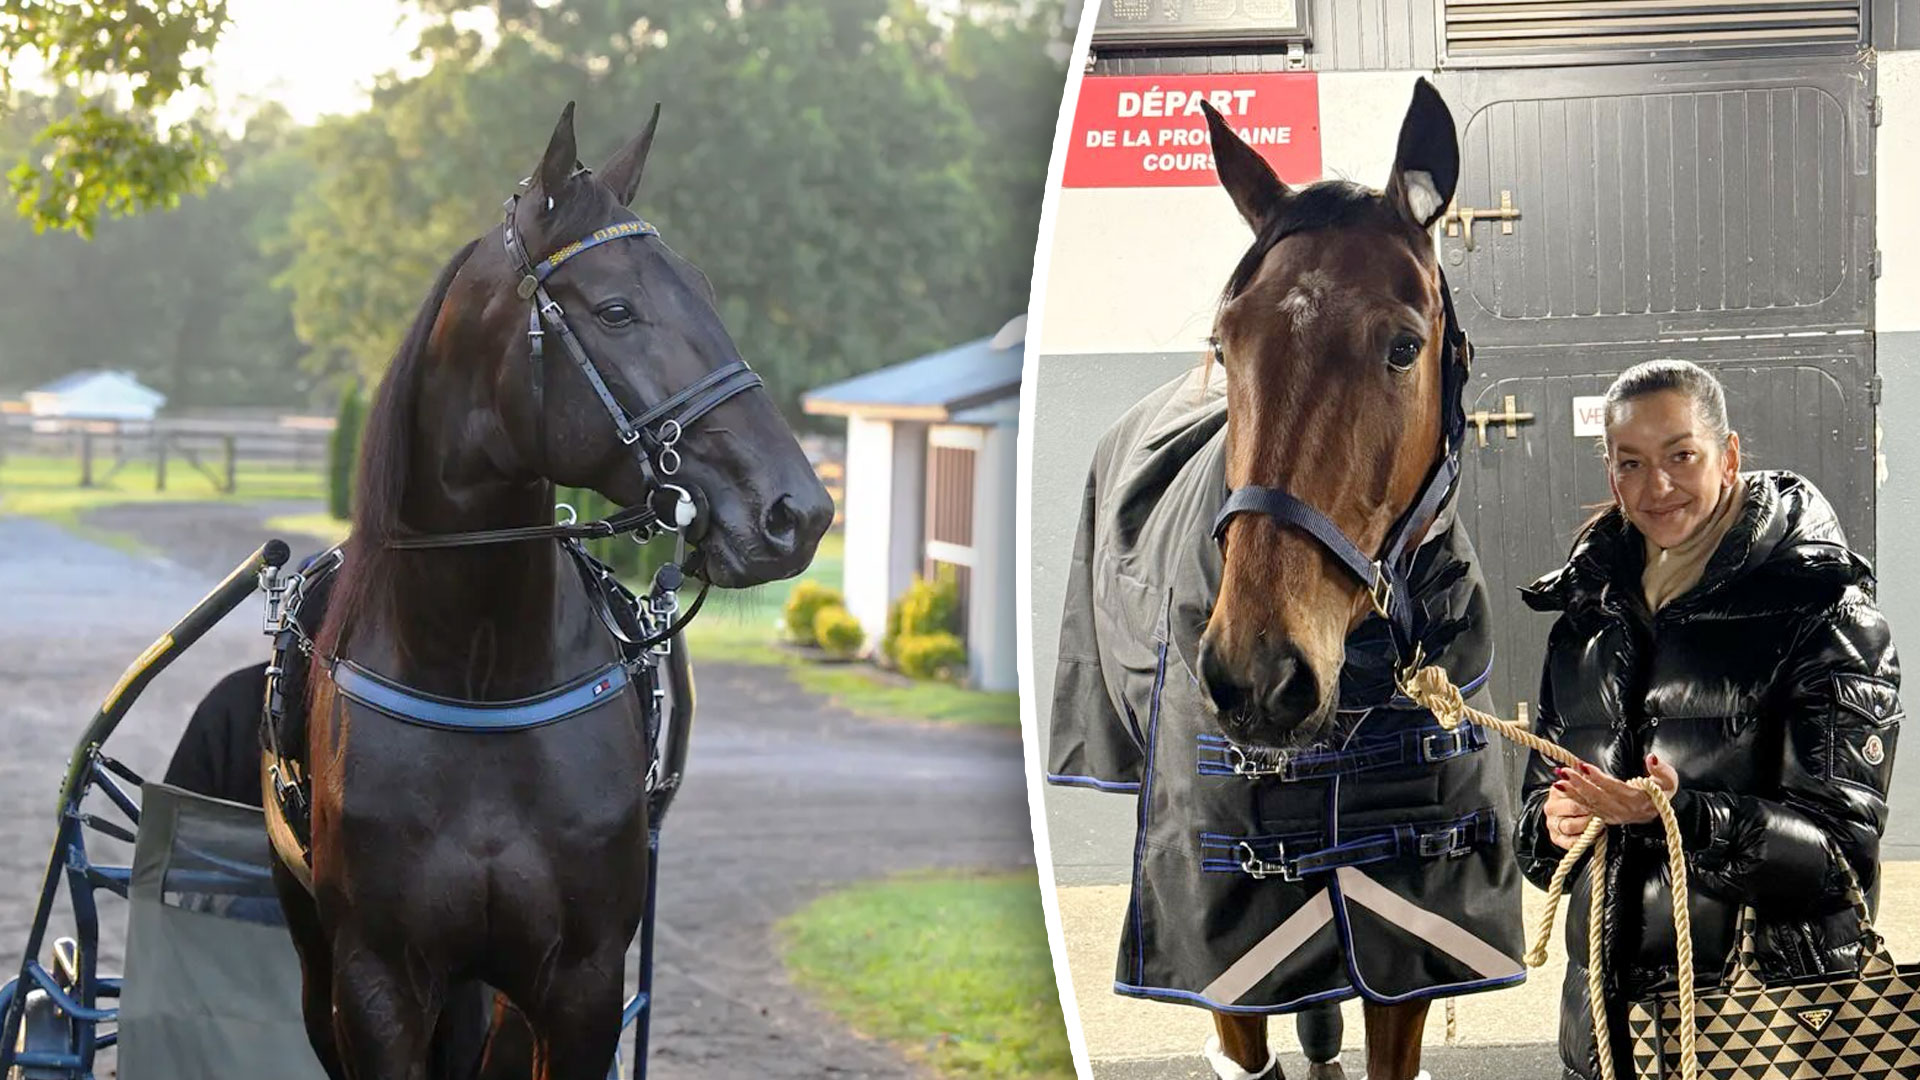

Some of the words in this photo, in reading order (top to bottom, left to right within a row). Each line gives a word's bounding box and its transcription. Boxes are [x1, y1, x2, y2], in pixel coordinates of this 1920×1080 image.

[1117, 86, 1256, 117] DÉPART
[1086, 130, 1117, 147] DE
[1122, 130, 1151, 147] LA
[1158, 127, 1292, 146] PROAINE
[1143, 153, 1217, 171] COURS
